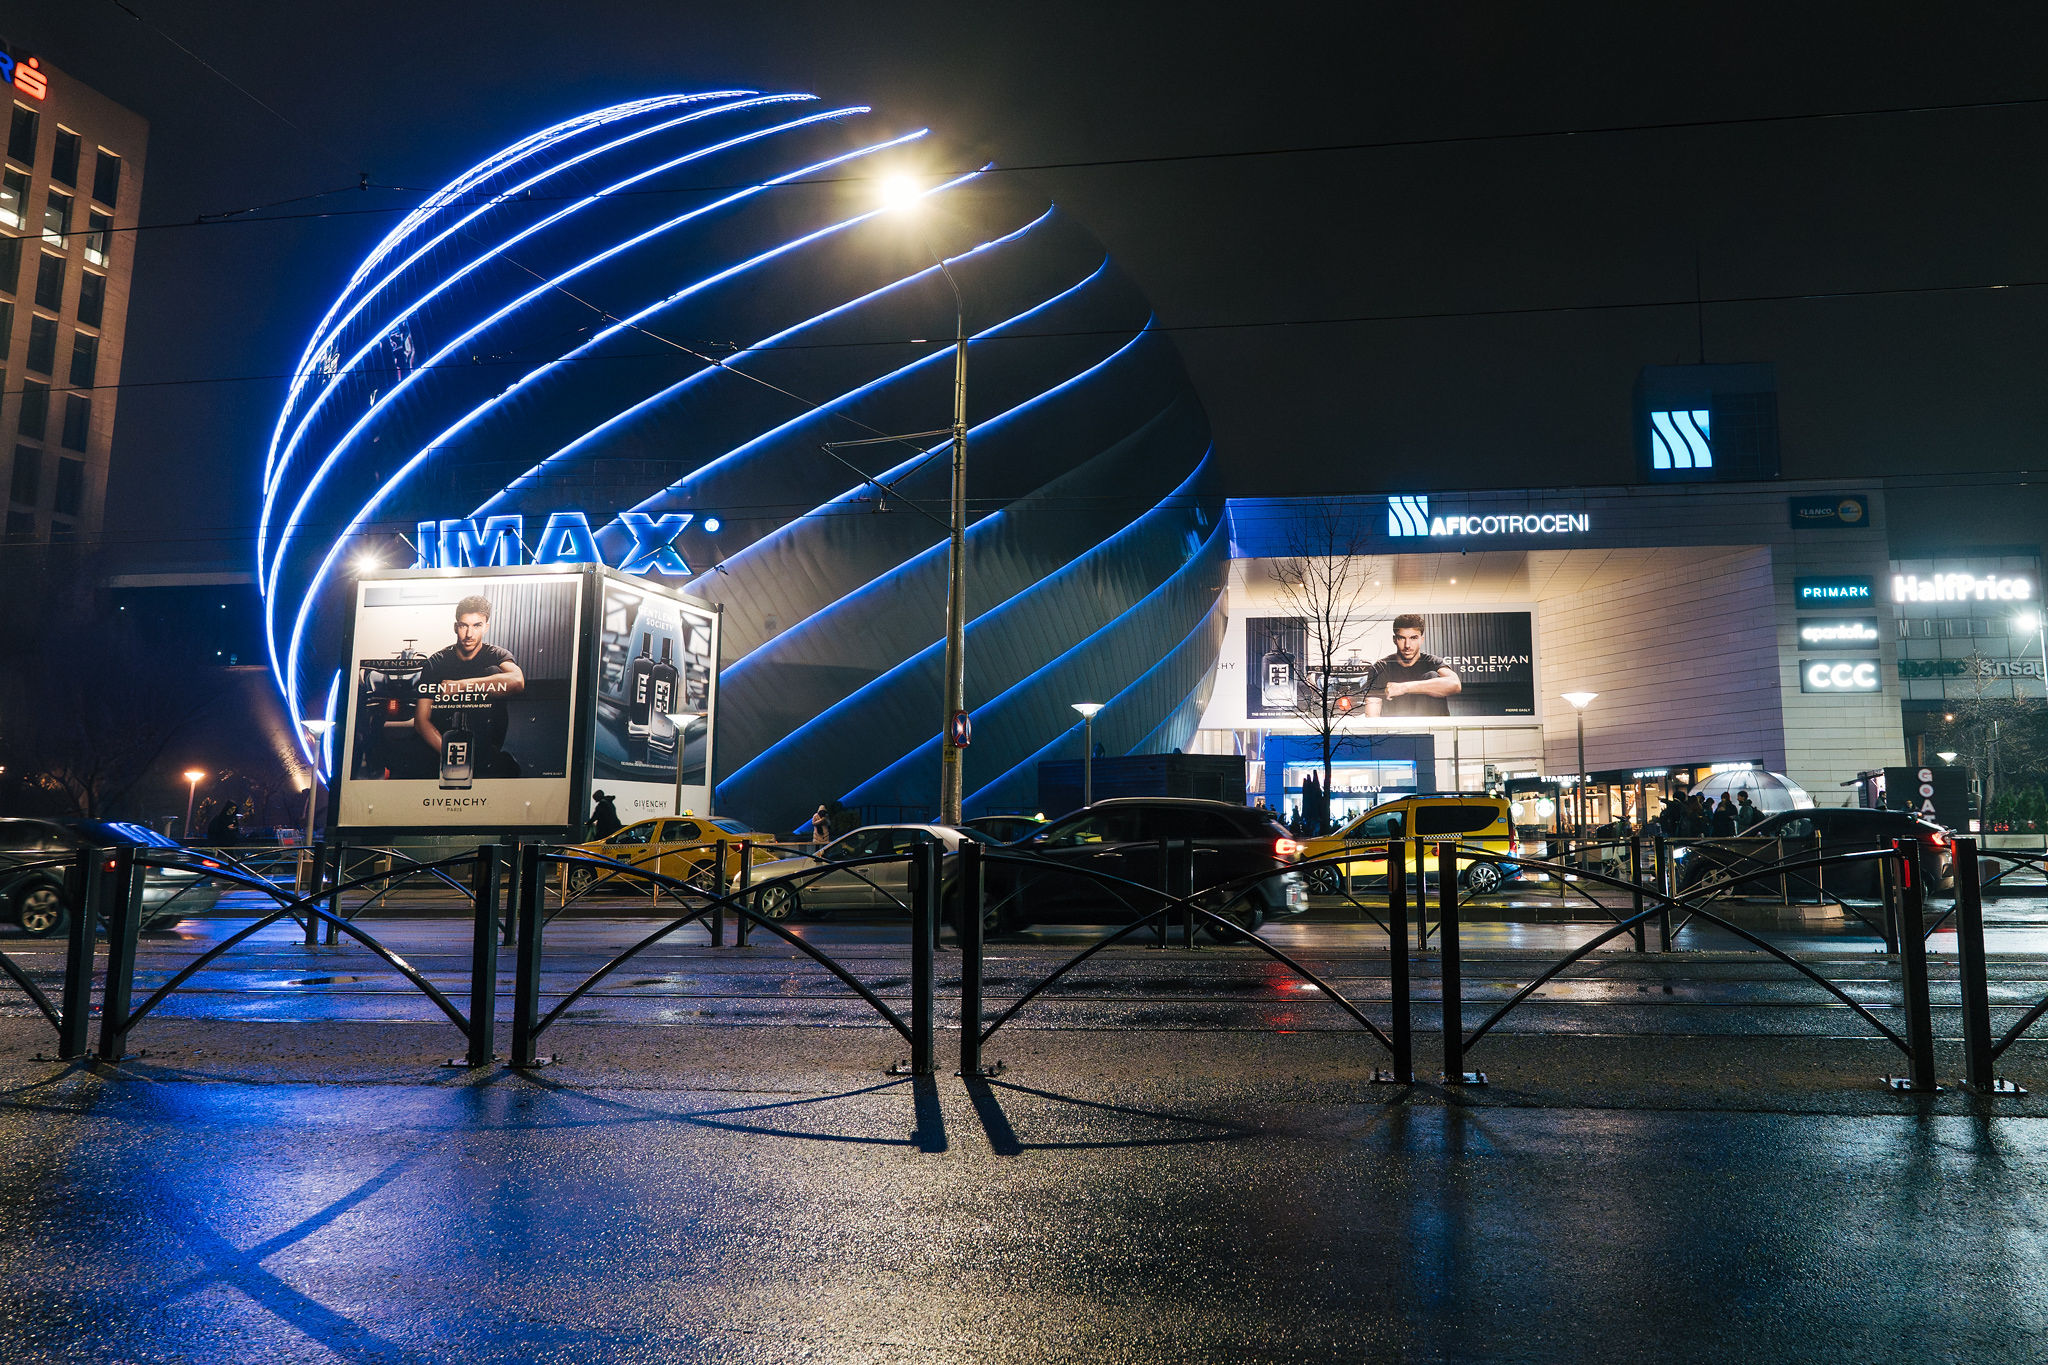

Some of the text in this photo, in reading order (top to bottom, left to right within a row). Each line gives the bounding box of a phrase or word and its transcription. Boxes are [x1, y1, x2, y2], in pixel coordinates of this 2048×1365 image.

[411, 511, 694, 576] IMAX
[1803, 586, 1869, 598] PRIMARK
[1894, 573, 2030, 602] HalfPrice
[646, 618, 673, 631] SOCIETY
[1443, 655, 1529, 665] GENTLEMAN
[1460, 665, 1512, 673] SOCIETY
[1808, 663, 1876, 687] CCC
[418, 682, 508, 694] GENTLEMAN
[434, 693, 489, 703] SOCIETY
[1541, 775, 1592, 783] STARBUCS
[1351, 784, 1383, 793] GALAXY
[422, 798, 488, 807] GIVENCHY
[633, 799, 667, 808] GIVENCHY
